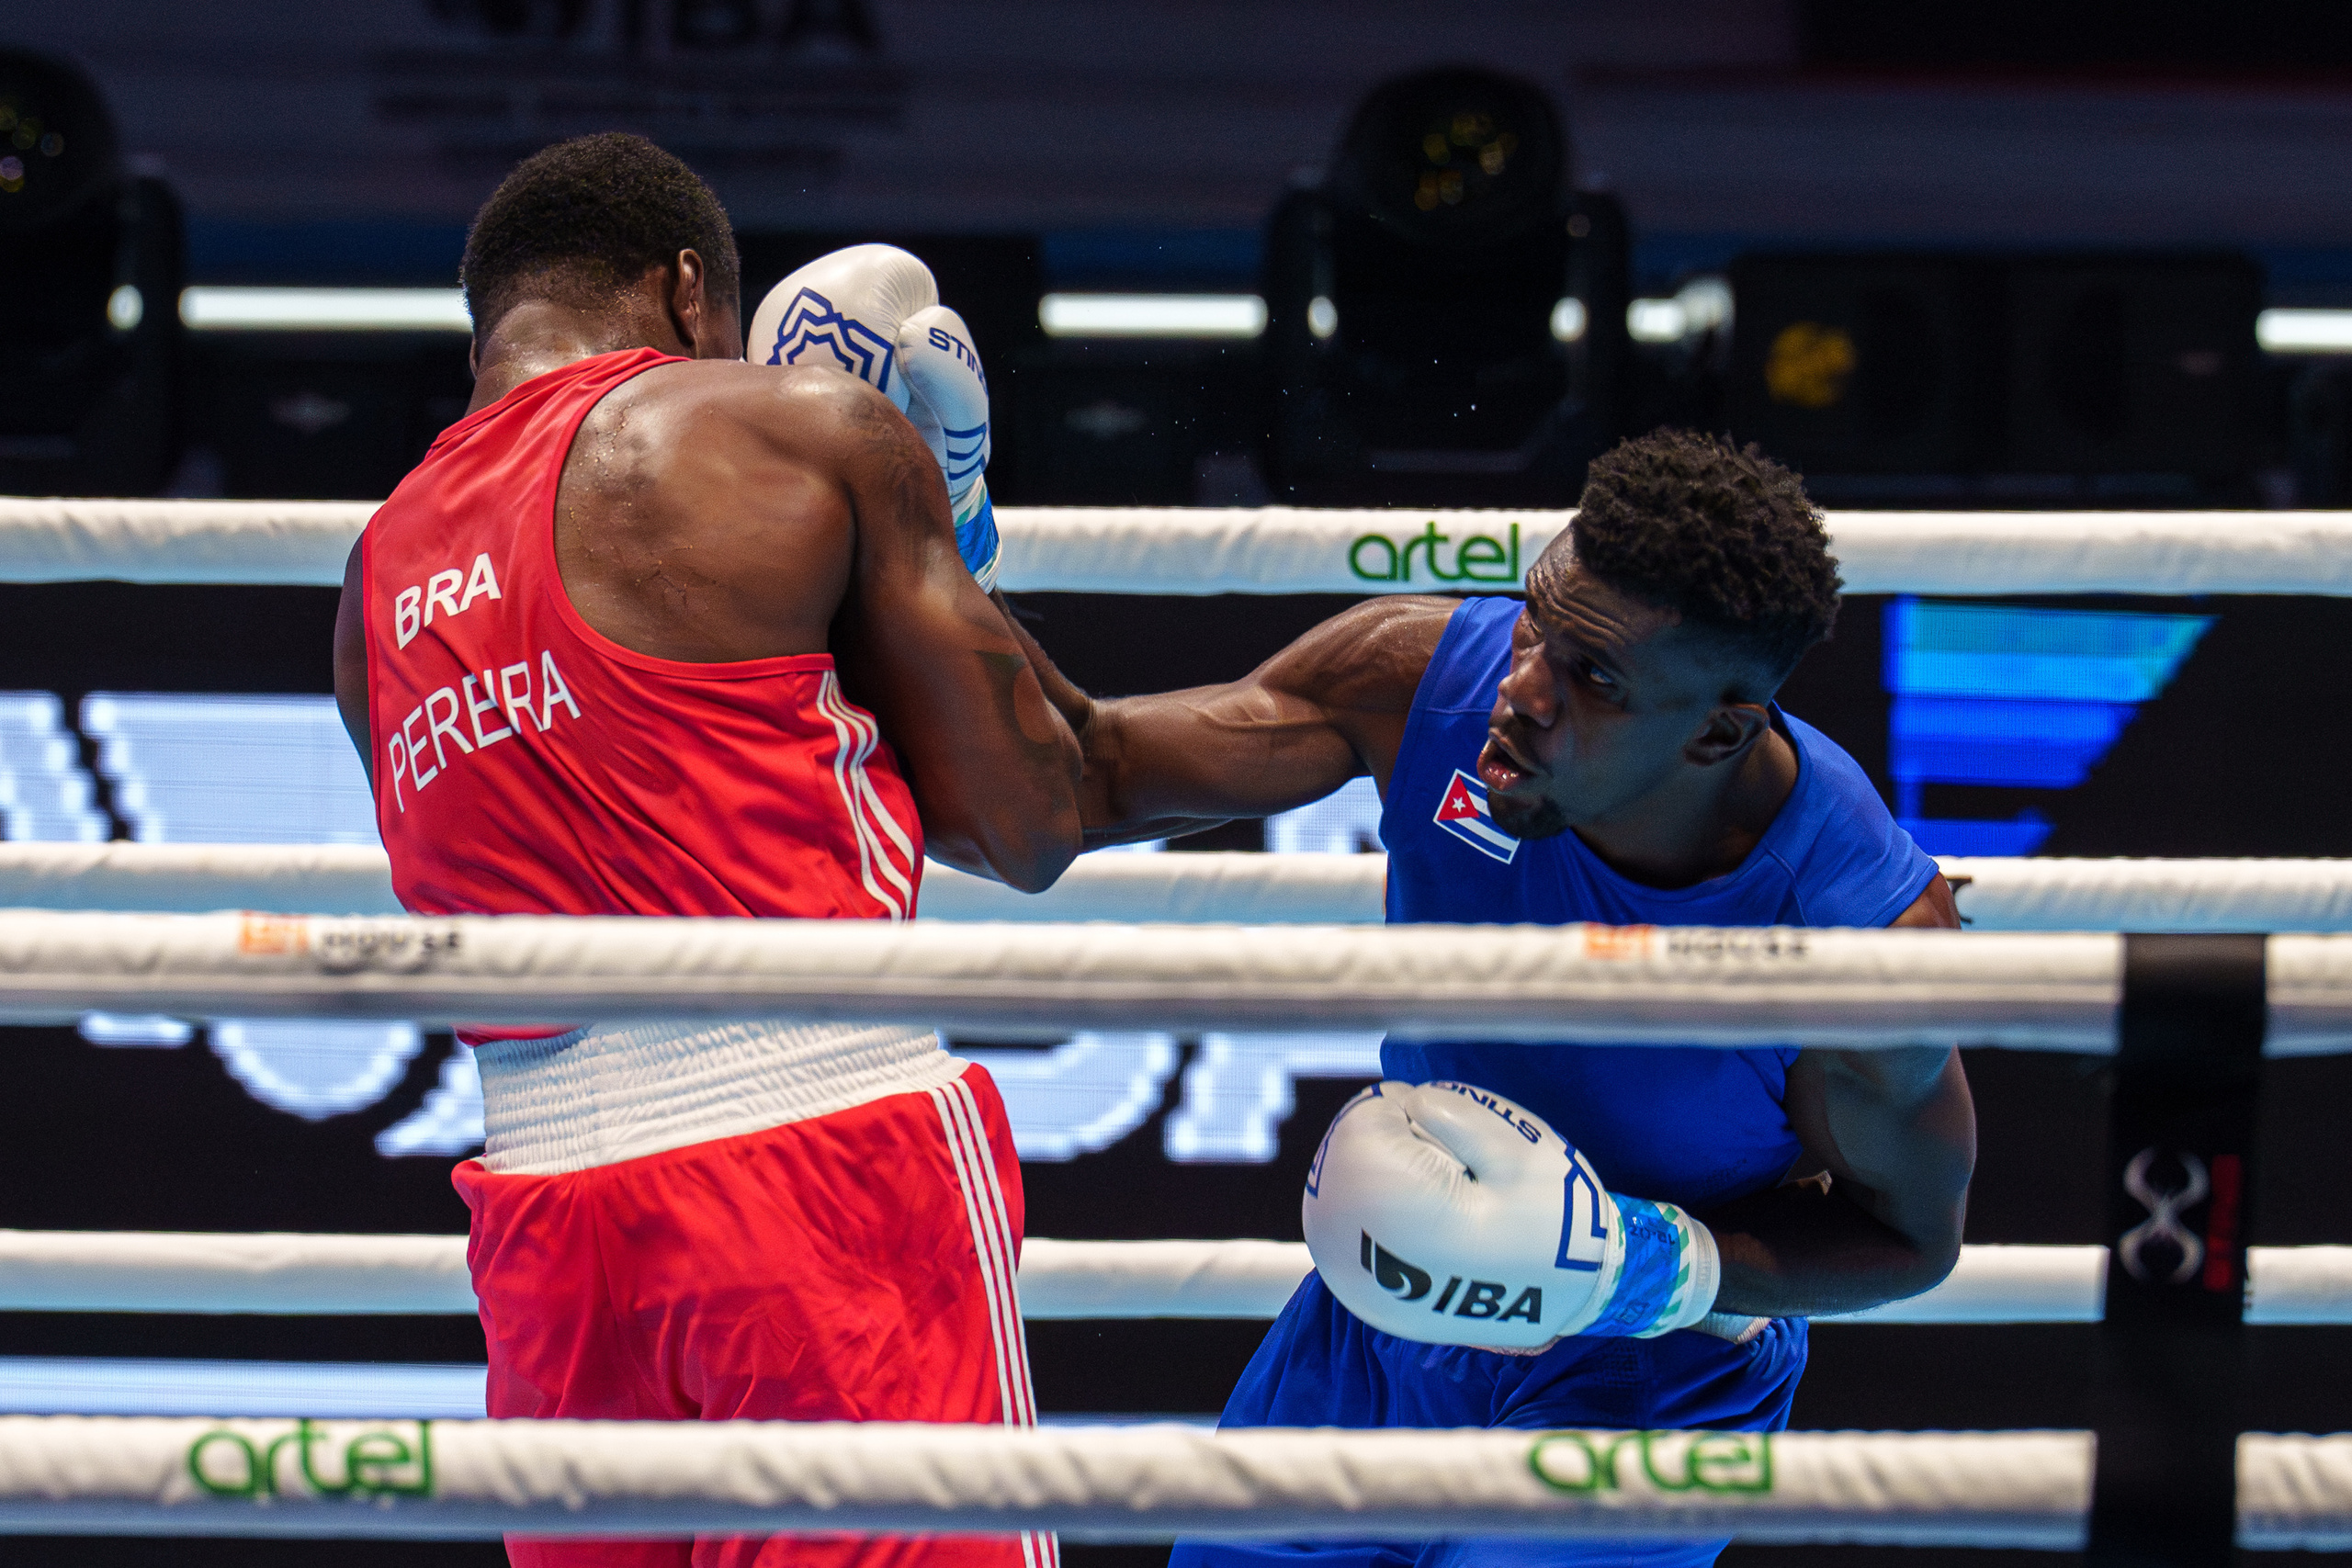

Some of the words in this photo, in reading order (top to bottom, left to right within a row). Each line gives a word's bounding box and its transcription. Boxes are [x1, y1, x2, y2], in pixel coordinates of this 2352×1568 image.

[928, 327, 988, 392] STIN
[1349, 520, 1520, 582] artel
[395, 552, 503, 650] BRA
[1431, 1275, 1544, 1325] IBA
[187, 1418, 434, 1499] artel
